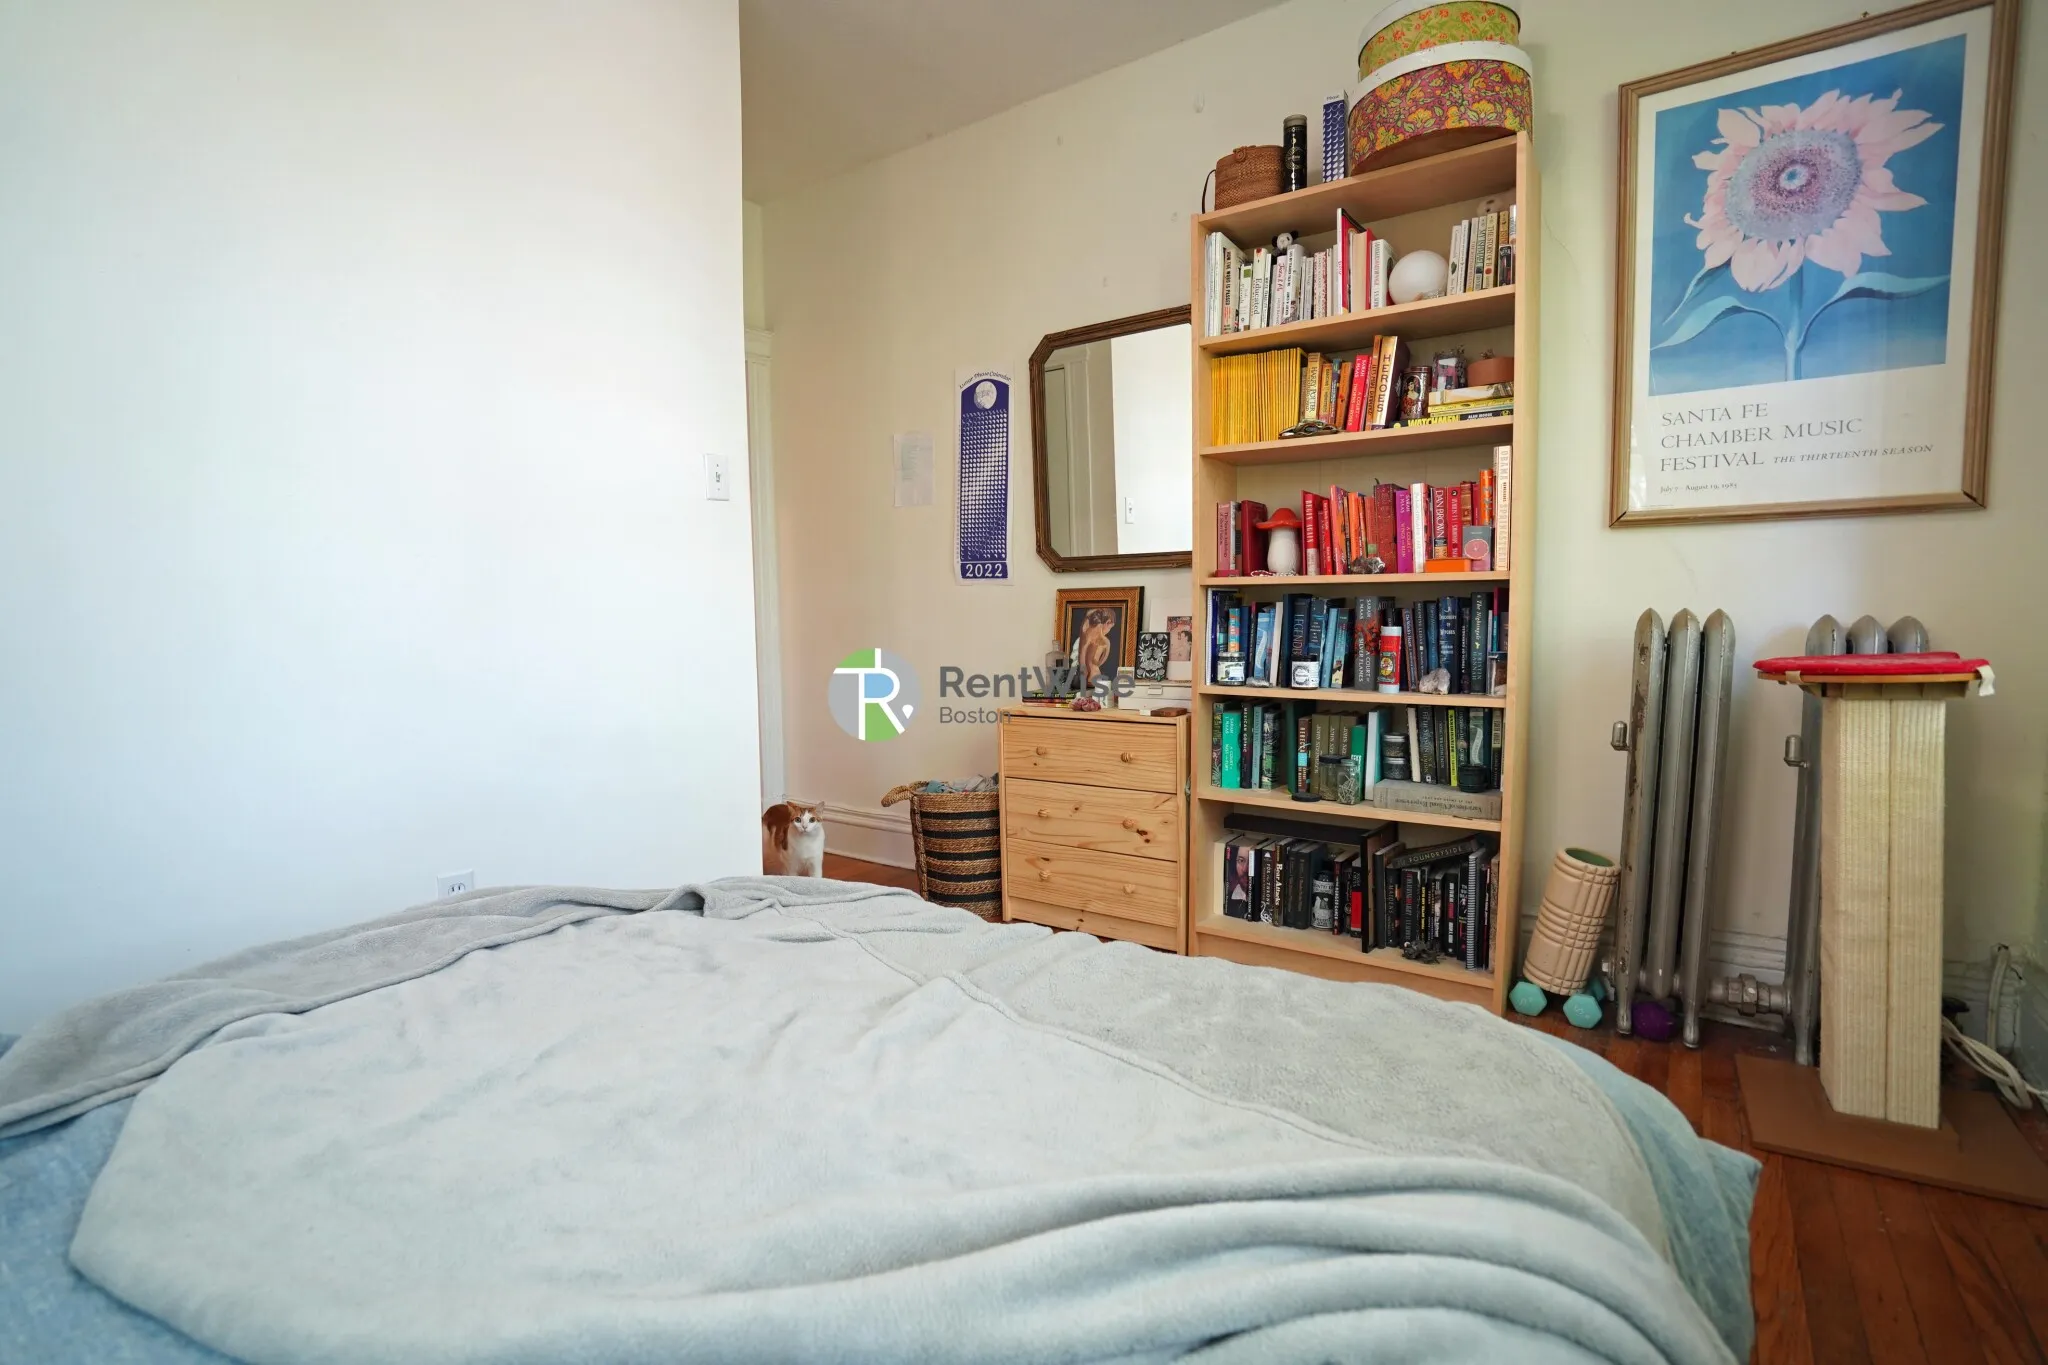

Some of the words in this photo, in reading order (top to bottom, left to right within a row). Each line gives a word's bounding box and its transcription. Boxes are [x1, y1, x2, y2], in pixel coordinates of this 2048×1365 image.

[1486, 238, 1494, 253] STORY
[1254, 278, 1262, 315] Educated
[960, 376, 973, 389] Lunar
[990, 371, 1011, 381] Calendar
[1377, 354, 1391, 412] HEROES
[1309, 389, 1317, 412] POTTER
[1408, 415, 1458, 427] WATCHMEN
[1662, 407, 1731, 426] SANTA
[1742, 402, 1768, 418] FE
[1661, 427, 1773, 449] CHAMBER
[1783, 418, 1862, 439] MUSIC
[1500, 451, 1508, 480] OBAMA
[1661, 452, 1764, 472] FESTIVAL
[1774, 456, 1796, 464] THE
[1800, 449, 1878, 461] THIRTEENTH
[1882, 444, 1934, 455] SEASON
[1436, 490, 1444, 508] DAN
[1660, 485, 1673, 494] July
[1685, 484, 1709, 492] August
[1436, 509, 1444, 538] BROWN
[965, 563, 1003, 578] 2022
[1395, 798, 1428, 807] Experience
[1409, 847, 1462, 862] FOUNDRYSIDE
